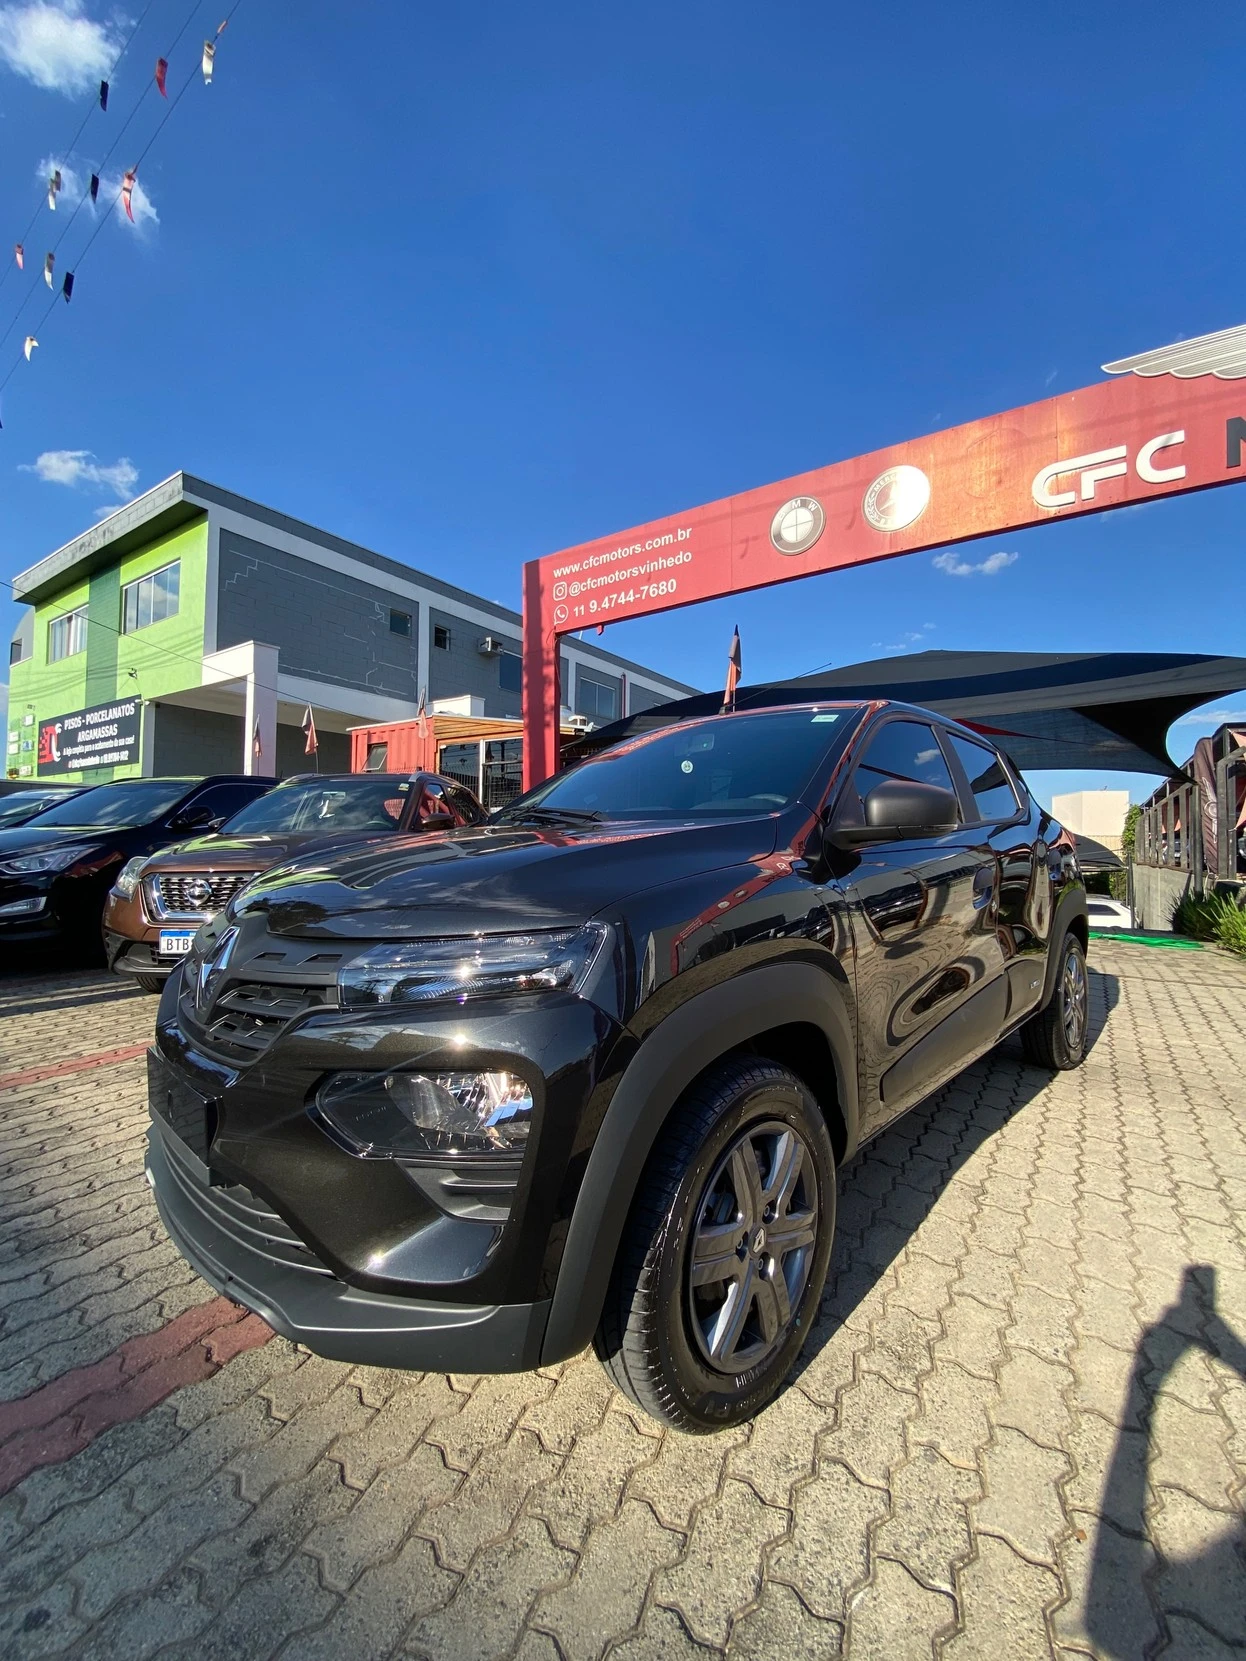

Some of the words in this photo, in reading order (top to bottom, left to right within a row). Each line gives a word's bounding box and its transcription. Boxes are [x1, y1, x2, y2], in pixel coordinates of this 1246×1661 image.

[1031, 429, 1186, 508] CFC
[553, 527, 692, 578] www.cfcmotors.com.br
[568, 551, 692, 597] @cfcmotorsvinhedo
[573, 604, 585, 617] 11
[589, 578, 677, 613] 9.4744-7680
[64, 716, 82, 730] PISOS
[85, 702, 135, 725] PORCELANATOS
[77, 723, 118, 743] ARGAMASSAS
